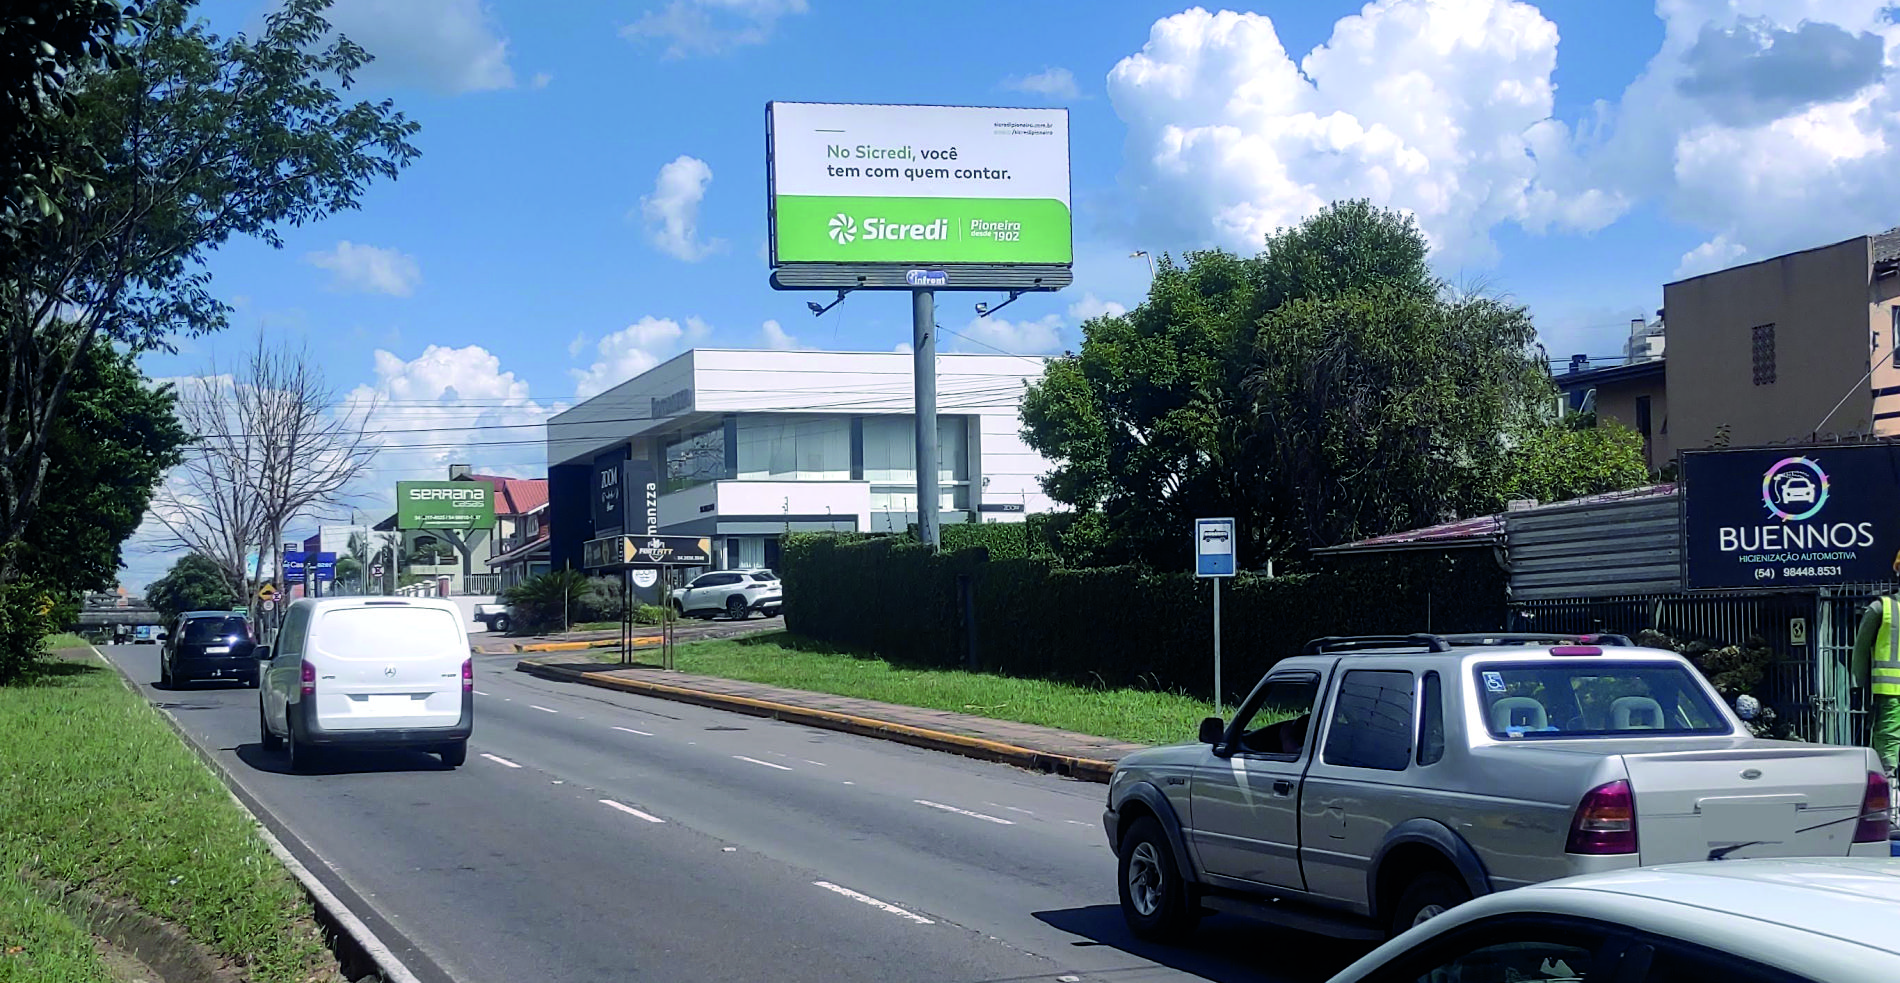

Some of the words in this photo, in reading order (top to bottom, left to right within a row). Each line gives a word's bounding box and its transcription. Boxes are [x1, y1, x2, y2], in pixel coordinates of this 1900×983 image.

[827, 145, 850, 158] No
[855, 145, 916, 162] Sicredi,
[920, 147, 958, 160] você
[827, 164, 860, 177] tem
[865, 167, 899, 178] com
[904, 168, 949, 181] quem
[954, 167, 1012, 180] contar.
[862, 217, 948, 240] Sicredi
[970, 219, 1021, 231] Pioneira
[993, 231, 1020, 241] 1902
[646, 482, 658, 536] manzza
[1719, 522, 1874, 551] BUENNOS
[1739, 552, 1800, 563] HIGIENIZAÇÃO
[1801, 551, 1857, 561] AUTOMOTIVA
[1754, 568, 1775, 580] (54)
[1783, 566, 1842, 577] 98448.8531
